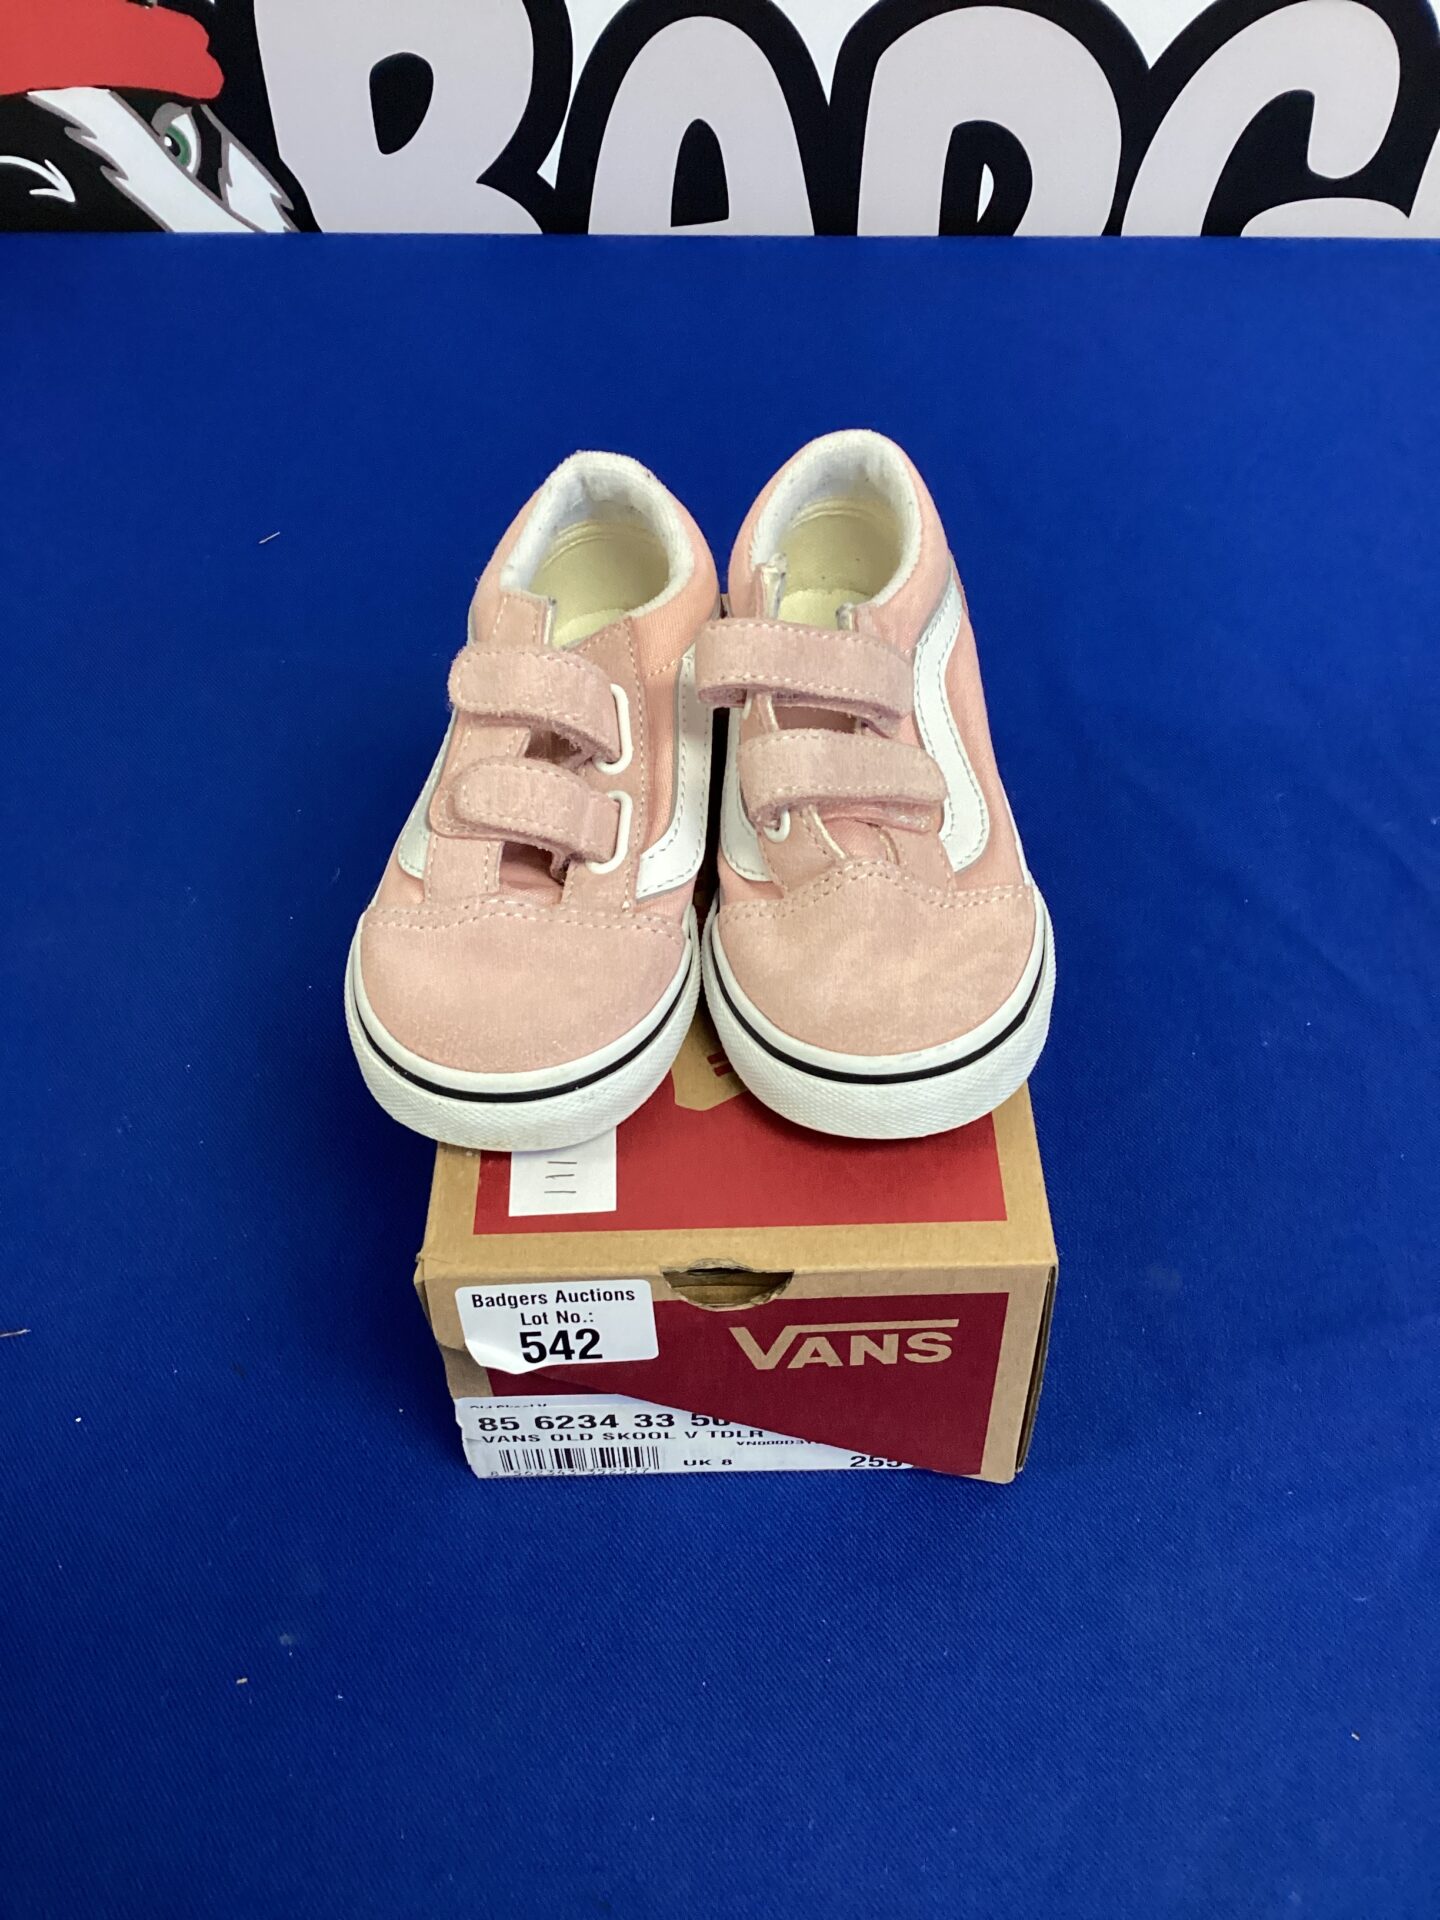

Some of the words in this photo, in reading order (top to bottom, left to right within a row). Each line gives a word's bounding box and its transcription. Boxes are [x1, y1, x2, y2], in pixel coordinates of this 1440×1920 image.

[471, 1292, 548, 1309] Badgers
[555, 1288, 636, 1304] Auctions
[520, 1311, 549, 1326] Lot
[556, 1310, 594, 1324] No.:
[519, 1328, 603, 1364] 542
[728, 1318, 960, 1370] VANS
[478, 1416, 520, 1432] 85
[534, 1414, 620, 1430] 6234
[634, 1413, 676, 1428] 33
[482, 1434, 541, 1444] VANS
[550, 1432, 594, 1442] OLD
[603, 1431, 677, 1441] SKOOL
[684, 1431, 699, 1439] V
[706, 1430, 764, 1439] TDLR
[683, 1459, 712, 1467] UK
[721, 1458, 733, 1466] 8
